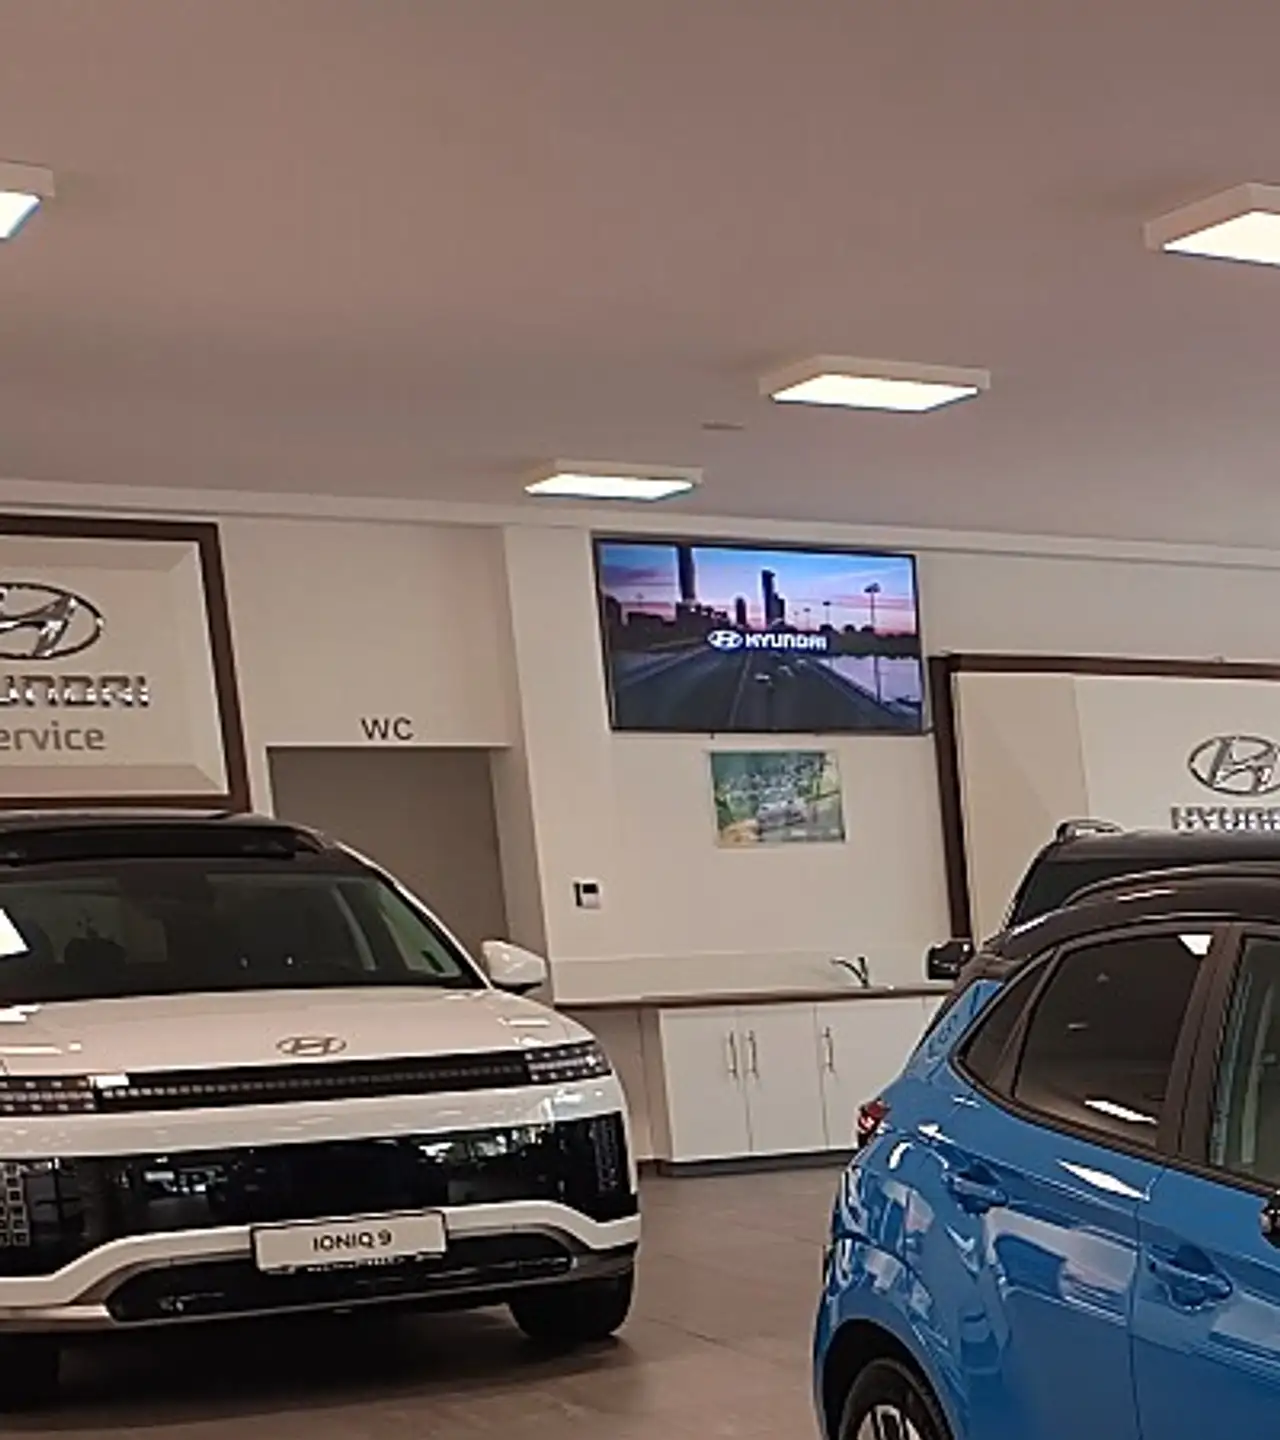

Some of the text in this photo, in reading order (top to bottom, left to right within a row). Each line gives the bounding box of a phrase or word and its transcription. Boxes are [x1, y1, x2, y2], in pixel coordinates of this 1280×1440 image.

[745, 633, 828, 651] HYUNDAI
[361, 717, 414, 741] WC
[312, 1229, 393, 1252] IONIQ 9
